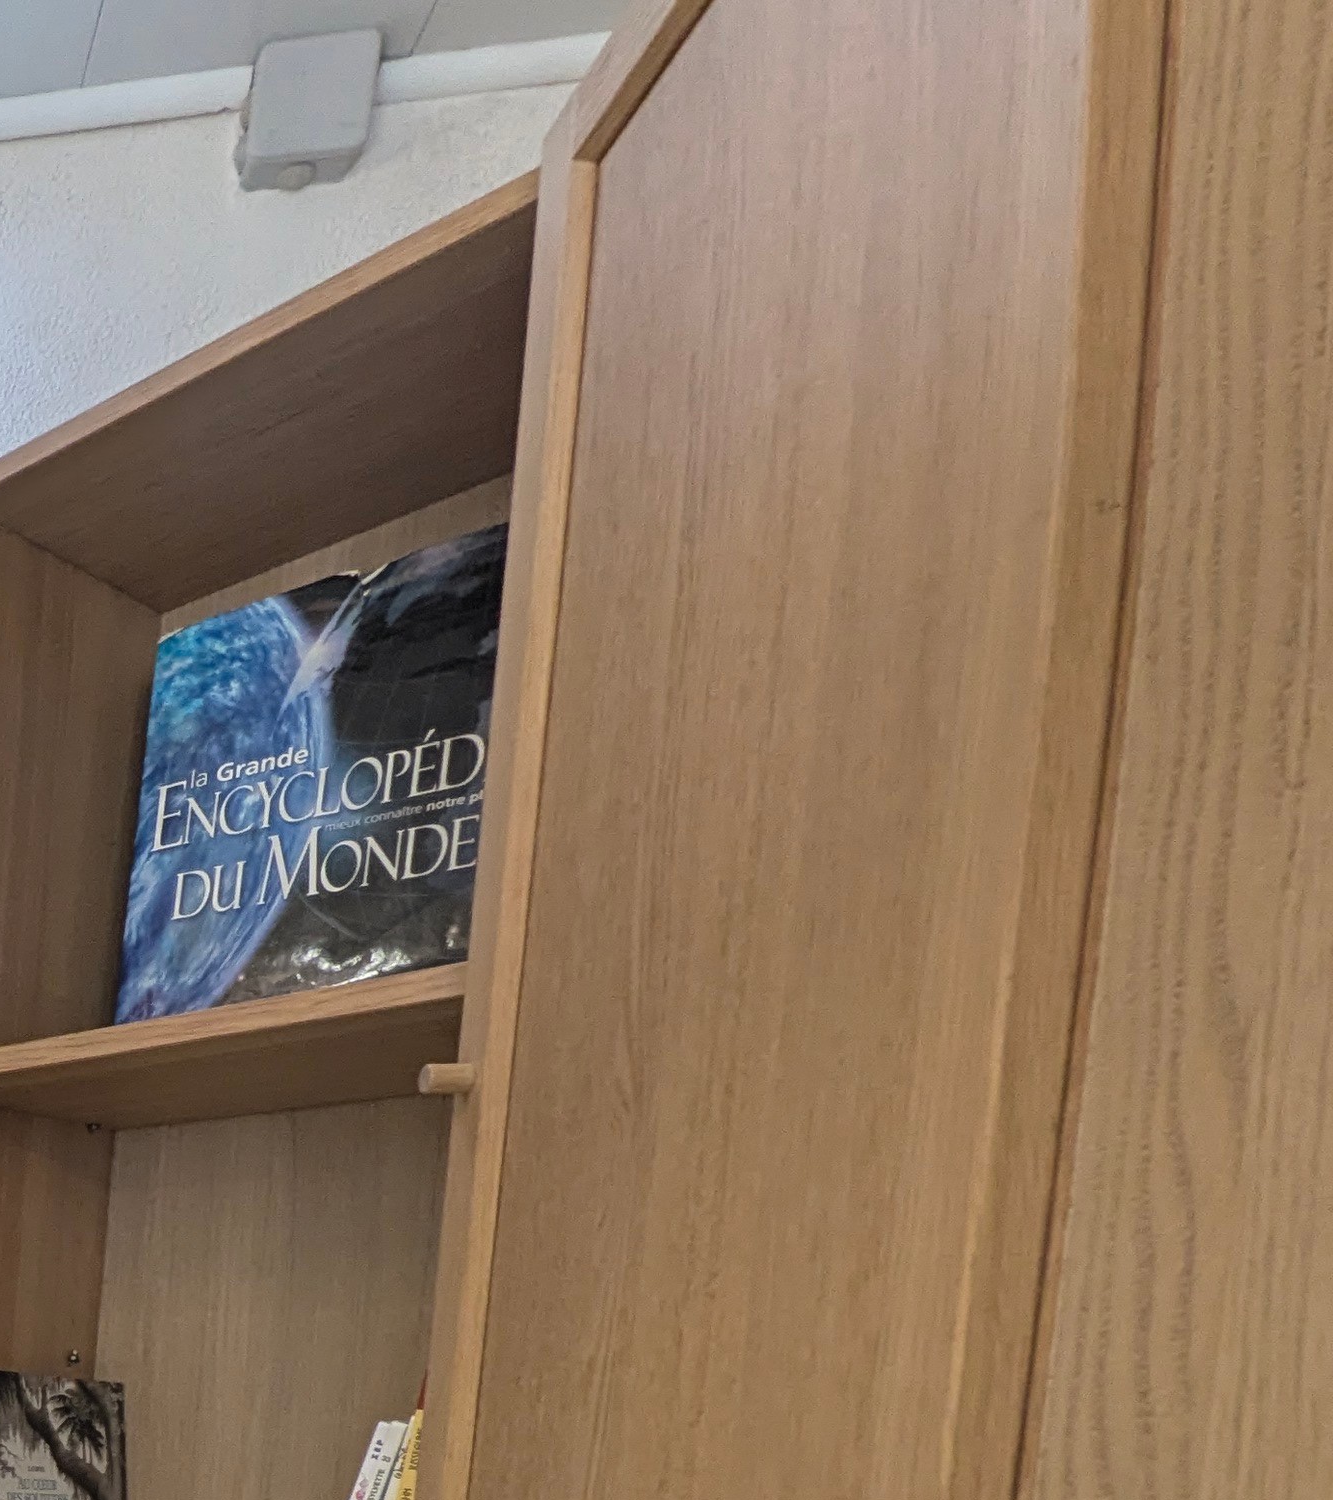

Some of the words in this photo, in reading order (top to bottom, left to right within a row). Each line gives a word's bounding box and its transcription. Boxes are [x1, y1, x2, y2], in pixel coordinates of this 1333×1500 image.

[150, 728, 486, 853] ENCYCLOPÉD
[190, 766, 208, 791] la
[216, 745, 309, 785] Grande
[326, 815, 362, 832] mieux
[365, 804, 423, 825] connaître
[426, 794, 466, 815] notre
[172, 858, 244, 922] DU
[257, 816, 480, 906] MONDE
